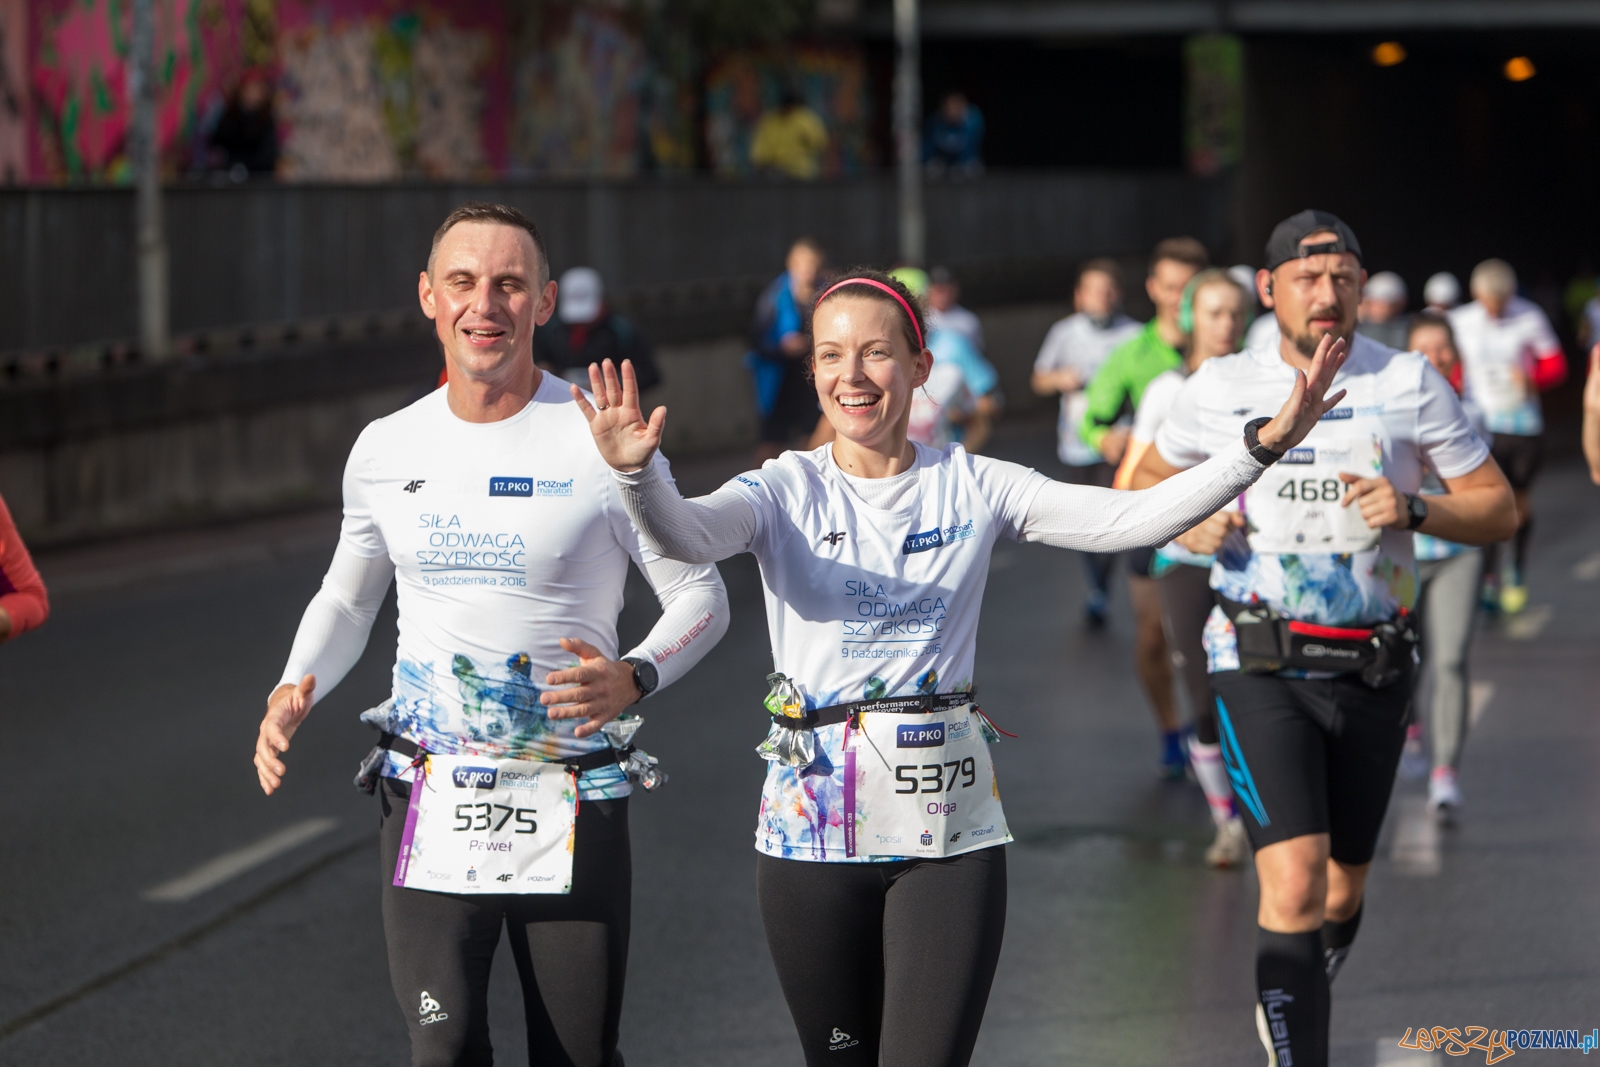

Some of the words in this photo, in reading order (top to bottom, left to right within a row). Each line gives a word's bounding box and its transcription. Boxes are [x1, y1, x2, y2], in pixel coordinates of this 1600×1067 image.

[403, 480, 426, 493] 4F
[493, 482, 507, 492] 17.
[507, 482, 530, 492] PKO
[418, 513, 461, 529] SIŁA
[429, 532, 525, 549] ODWAGA
[823, 531, 846, 546] 4F
[904, 540, 919, 549] 17.
[918, 533, 939, 547] PKO
[416, 550, 526, 567] SZYBKOŚĆ
[423, 576, 430, 586] 9
[432, 575, 497, 587] października
[500, 577, 527, 587] 2016
[845, 580, 888, 598] SIŁA
[857, 597, 947, 618] ODWAGA
[843, 613, 946, 636] SZYBKOŚĆ
[841, 648, 849, 658] 9
[851, 647, 918, 660] października
[920, 643, 942, 657] 2016
[860, 700, 920, 712] performance
[902, 731, 917, 742] 17.
[918, 729, 942, 742] PKO
[948, 728, 972, 740] maraton
[470, 772, 493, 783] PKO
[895, 756, 975, 795] 5379
[499, 780, 539, 789] maraton
[926, 802, 957, 817] Olga
[453, 803, 538, 834] 5375
[469, 839, 513, 852] Paweł
[496, 873, 513, 882] 4F
[419, 1012, 449, 1026] odlo
[828, 1040, 859, 1051] odlo
